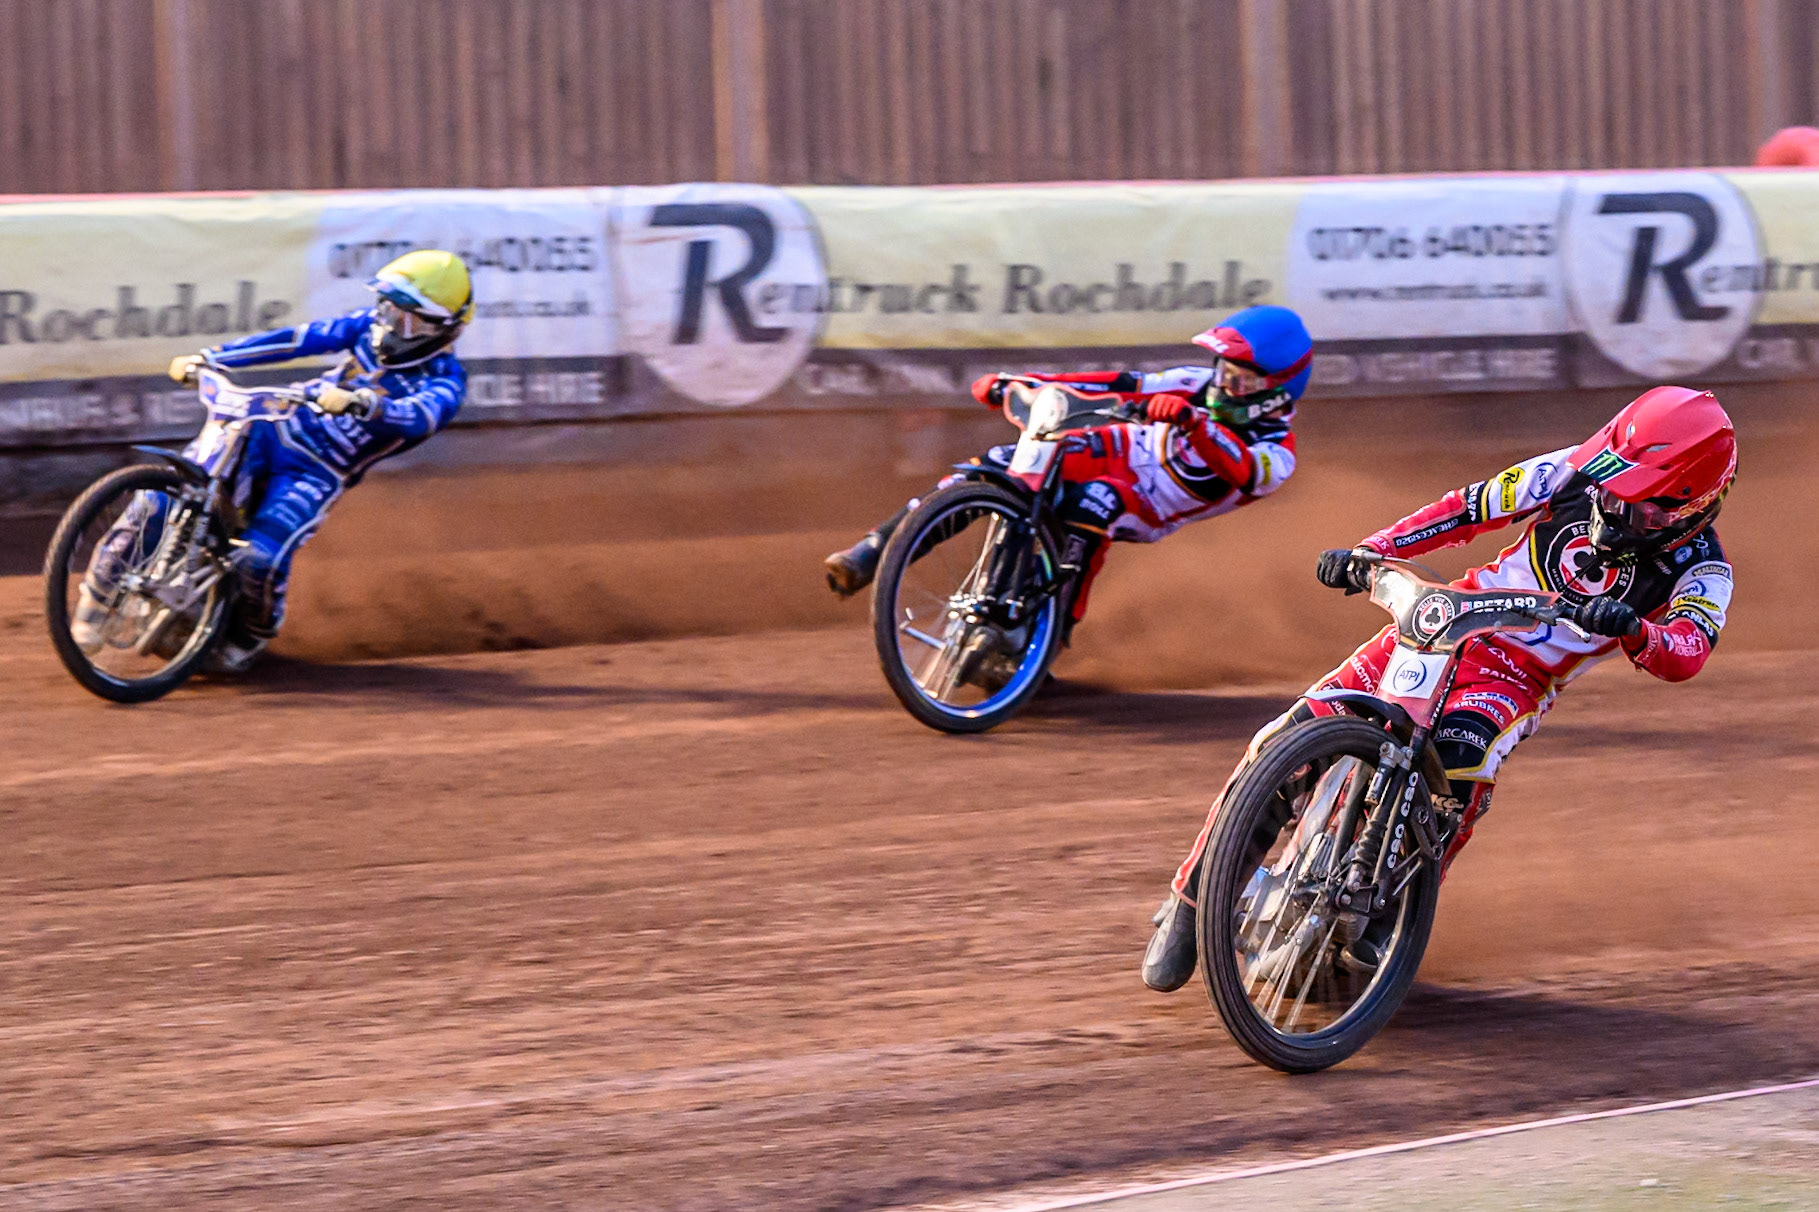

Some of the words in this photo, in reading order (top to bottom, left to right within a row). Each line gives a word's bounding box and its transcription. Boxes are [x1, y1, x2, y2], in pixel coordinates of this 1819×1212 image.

[1003, 260, 1273, 314] Rochdale
[0, 279, 293, 345] Rochdale
[1473, 596, 1537, 614] BETARD
[1398, 669, 1421, 682] ATPI
